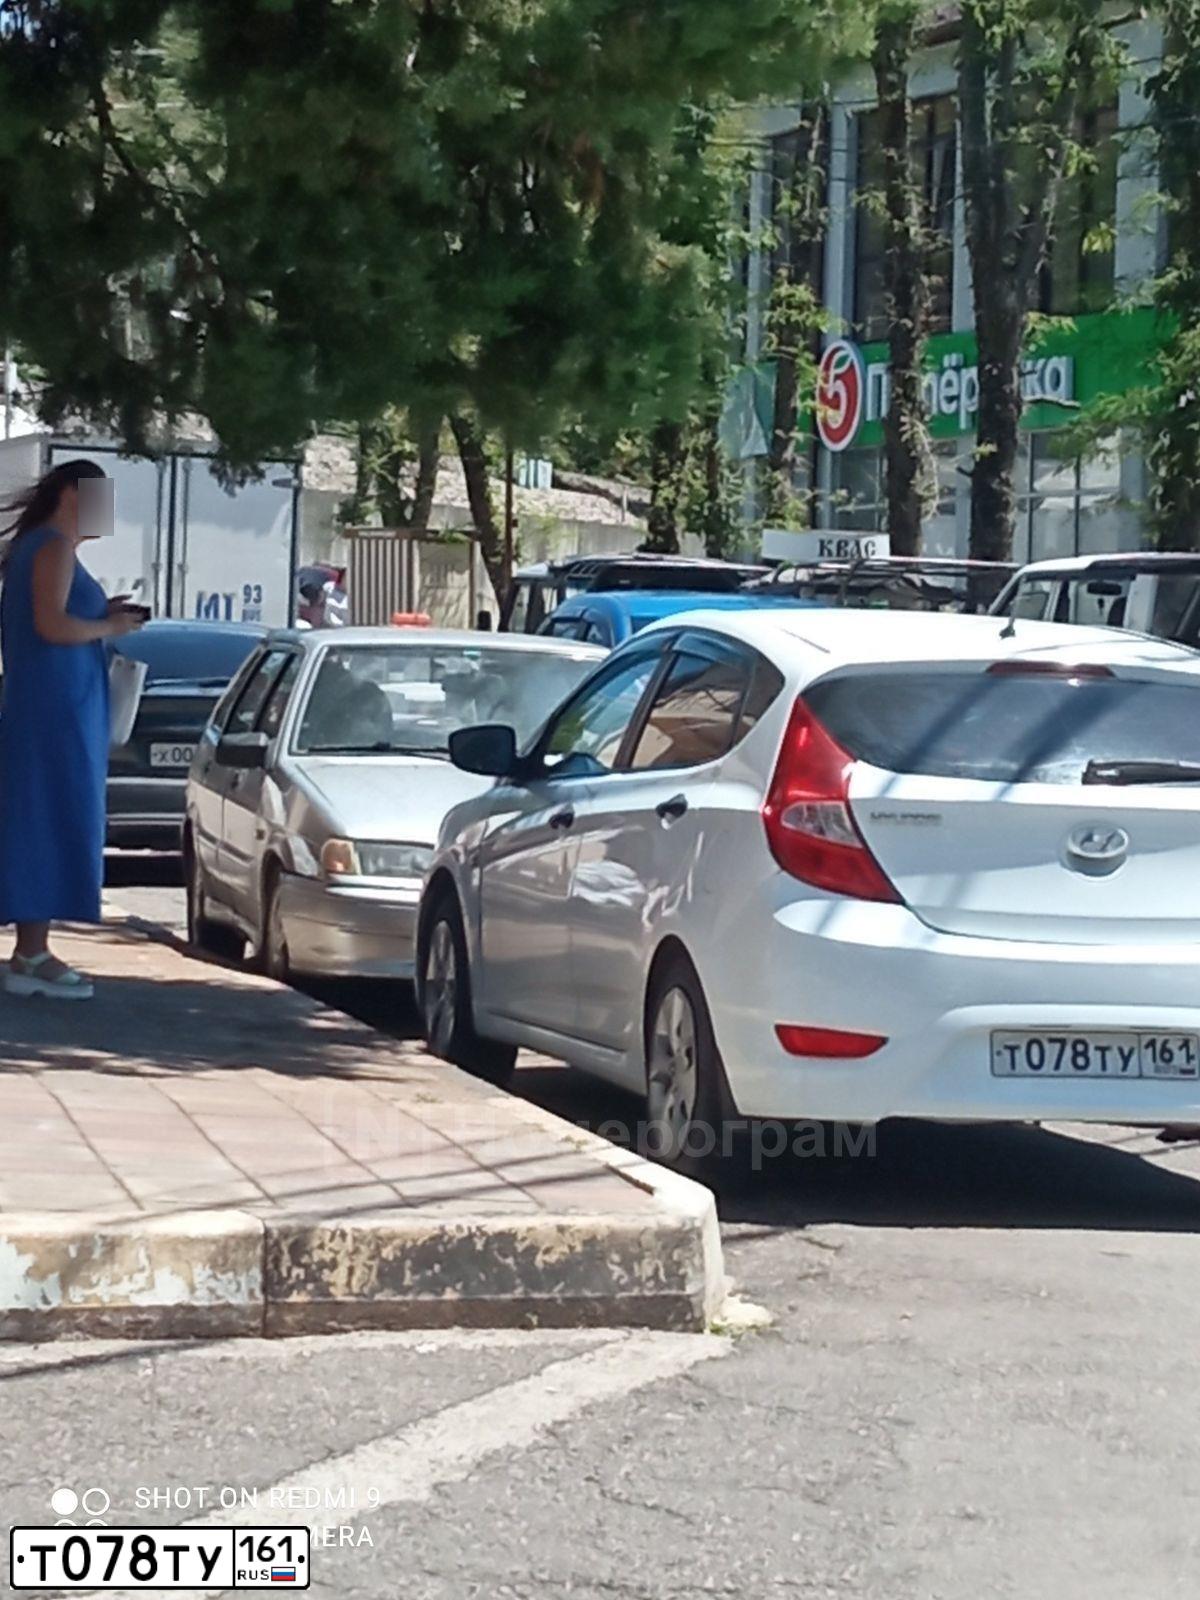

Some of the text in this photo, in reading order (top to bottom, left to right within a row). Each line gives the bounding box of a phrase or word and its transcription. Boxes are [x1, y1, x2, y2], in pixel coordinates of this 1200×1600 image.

[866, 353, 1073, 430] Пёрка
[818, 538, 876, 559] КВАС
[1144, 1038, 1192, 1065] 161
